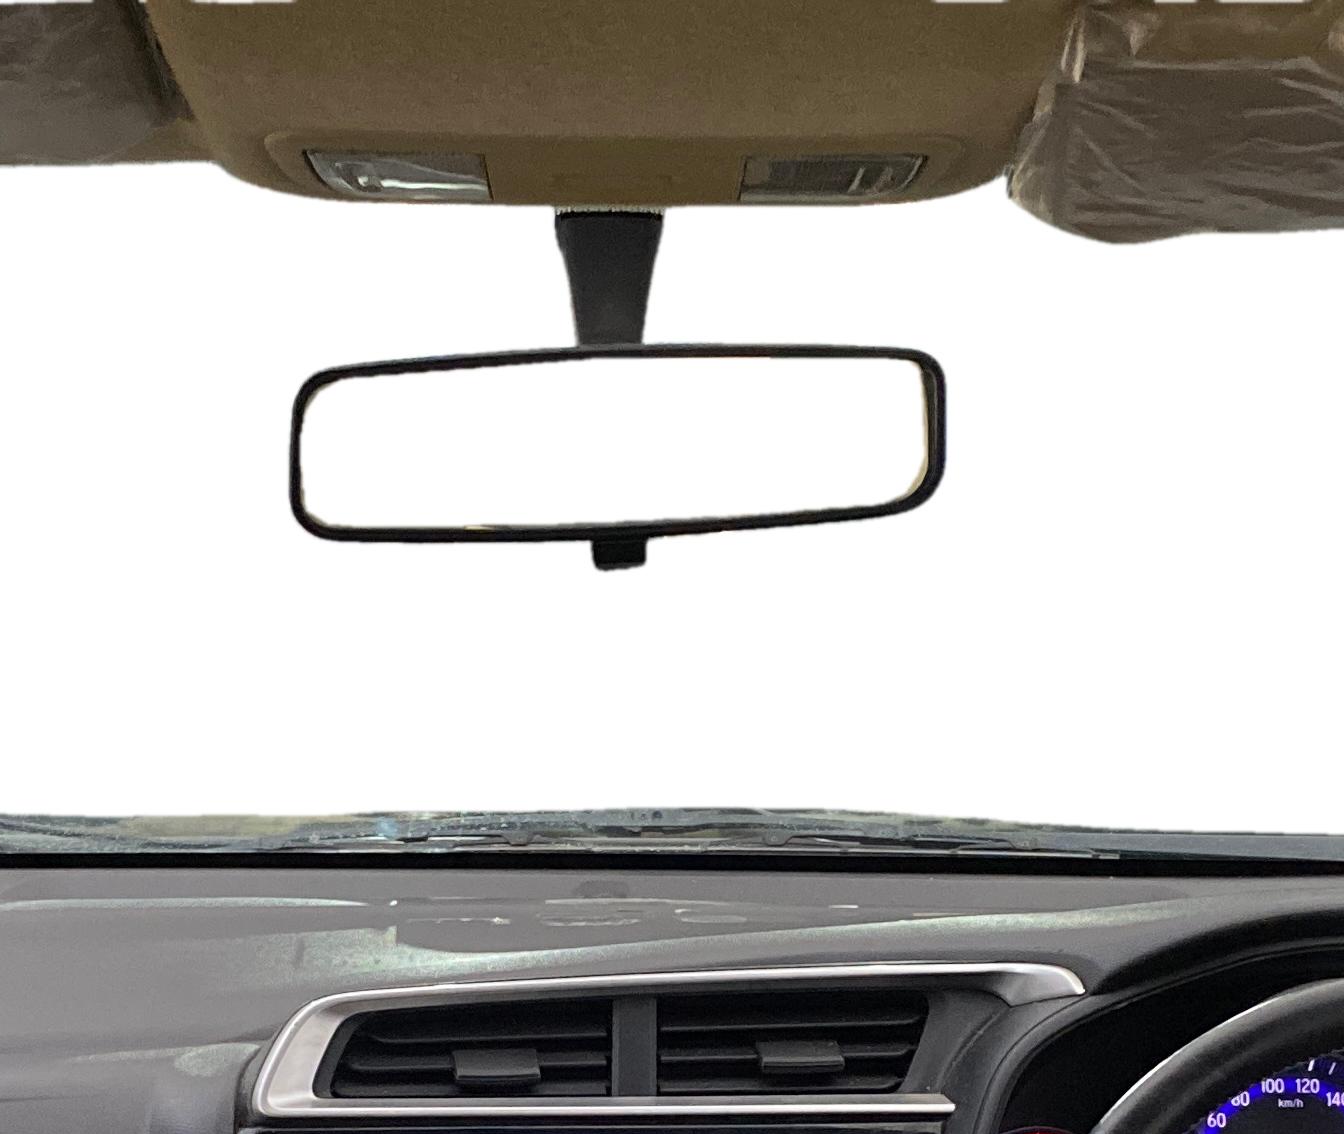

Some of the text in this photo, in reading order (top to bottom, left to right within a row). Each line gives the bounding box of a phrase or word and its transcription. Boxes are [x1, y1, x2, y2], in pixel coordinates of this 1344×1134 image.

[1261, 1078, 1285, 1094] 100
[1295, 1078, 1320, 1094] 120
[1230, 1091, 1250, 1107] 80
[1277, 1098, 1304, 1109] km/h
[1207, 1112, 1227, 1128] 60
